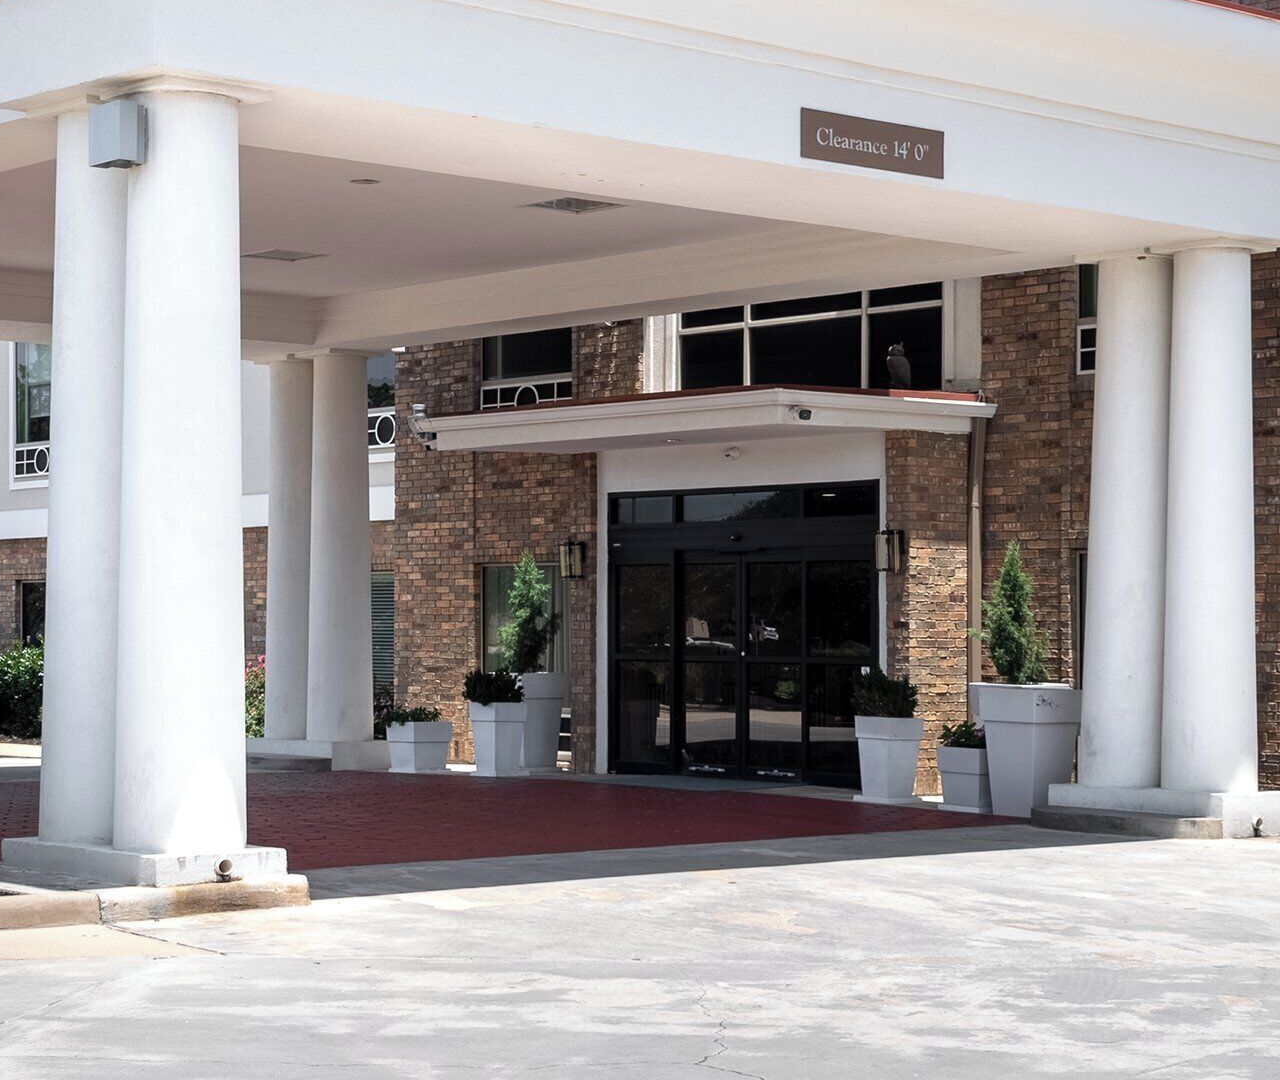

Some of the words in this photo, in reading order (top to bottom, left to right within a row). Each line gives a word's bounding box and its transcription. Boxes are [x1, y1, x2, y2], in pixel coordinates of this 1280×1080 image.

[816, 127, 888, 156] Clearance
[893, 141, 911, 160] 14'
[914, 143, 929, 161] 0"
